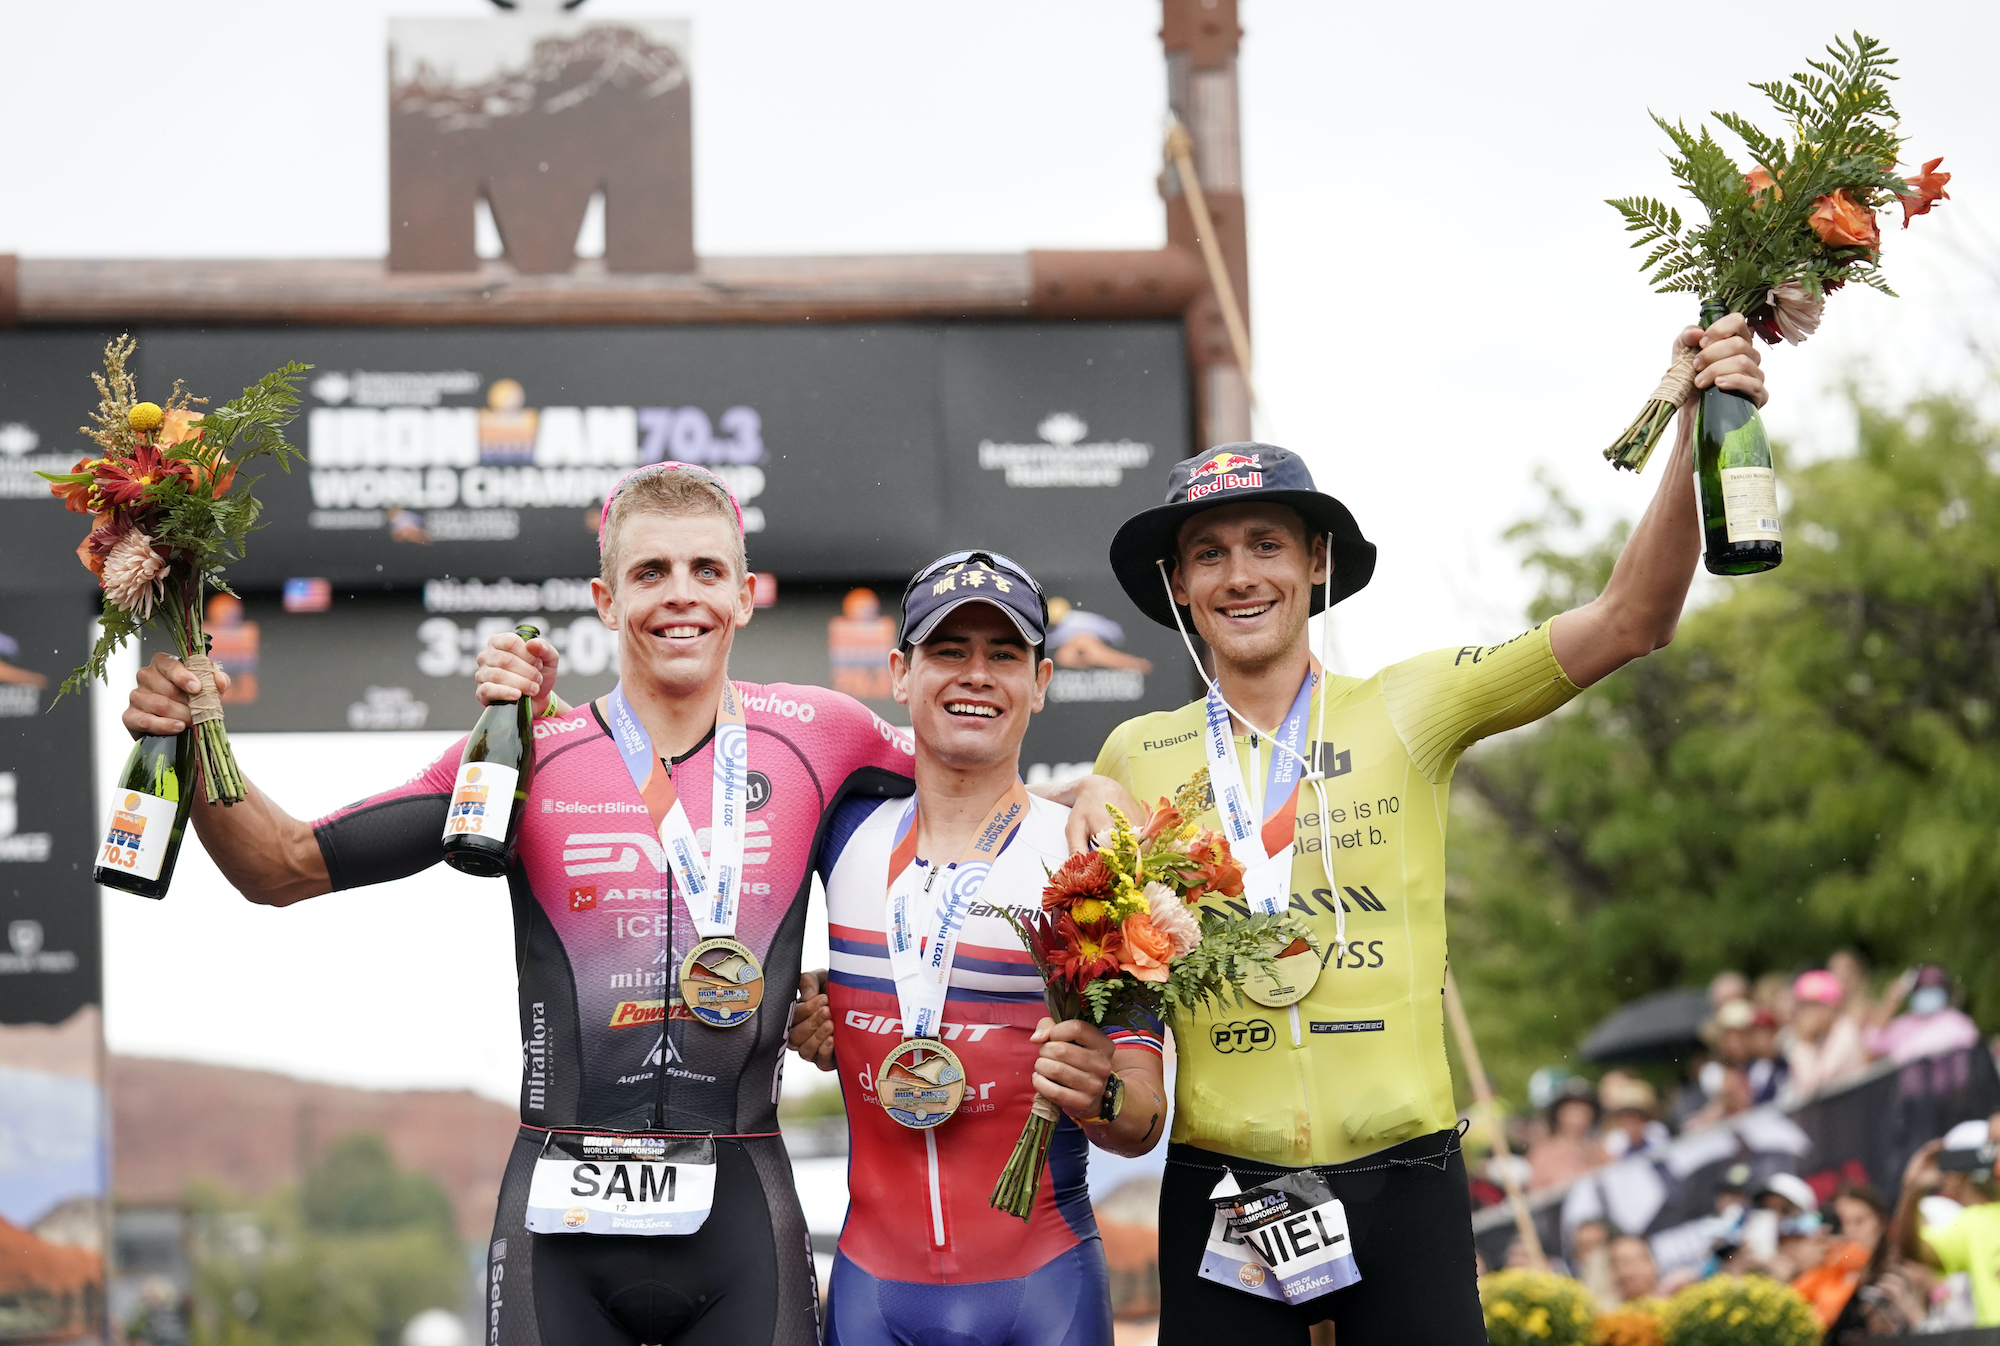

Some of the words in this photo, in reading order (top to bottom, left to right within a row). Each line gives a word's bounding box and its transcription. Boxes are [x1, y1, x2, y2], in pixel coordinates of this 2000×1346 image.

[638, 405, 765, 464] 70.3
[310, 467, 460, 508] WORLD
[1187, 478, 1223, 501] Red
[1223, 471, 1263, 490] Bull
[532, 717, 587, 739] ahoo
[1206, 700, 1221, 738] FINISHER
[1143, 730, 1198, 751] FUSION
[1215, 738, 1226, 759] 2021
[1277, 750, 1285, 770] LAND
[725, 757, 734, 801] FINISHER
[724, 804, 733, 827] 2021
[1353, 801, 1371, 820] is
[1378, 796, 1400, 815] no
[448, 816, 483, 834] 70.3
[974, 834, 986, 850] THE
[984, 821, 997, 841] LAND
[995, 812, 1003, 824] OF
[982, 802, 1022, 852] ENDURANCE.
[672, 838, 683, 855] 70.3
[1293, 829, 1363, 857] lanet
[1369, 825, 1387, 845] b.
[101, 844, 138, 868] 70.3
[713, 881, 726, 923] IRONMAN
[720, 865, 728, 882] 70.3
[724, 866, 732, 906] CHAMPIONSHIP
[616, 914, 675, 939] ICE
[932, 942, 944, 968] 2021
[938, 893, 962, 939] FINISHER
[941, 939, 952, 973] SEPTEMBER
[918, 1007, 927, 1023] 70.3
[1214, 1026, 1270, 1046] PTO
[1311, 1021, 1383, 1033] ceramicspeed
[527, 1002, 546, 1110] miraflora
[616, 1072, 654, 1085] Aqua
[665, 1067, 717, 1083] Sphere
[583, 1136, 641, 1147] IRONMAN
[641, 1138, 666, 1147] 70.3
[609, 1147, 665, 1155] CHAMPIONSHIP
[570, 1163, 677, 1203] SAM
[615, 1204, 627, 1212] 12
[1220, 1199, 1262, 1218] RONMAN
[1261, 1191, 1287, 1208] 70.3
[1237, 1202, 1289, 1225] CHAMPIONSHIP
[612, 1221, 672, 1229] ENDURANCE.
[1244, 1267, 1262, 1276] RISE
[1283, 1280, 1301, 1290] LAND
[1301, 1276, 1311, 1284] OF
[1284, 1275, 1333, 1297] DURANCE.
